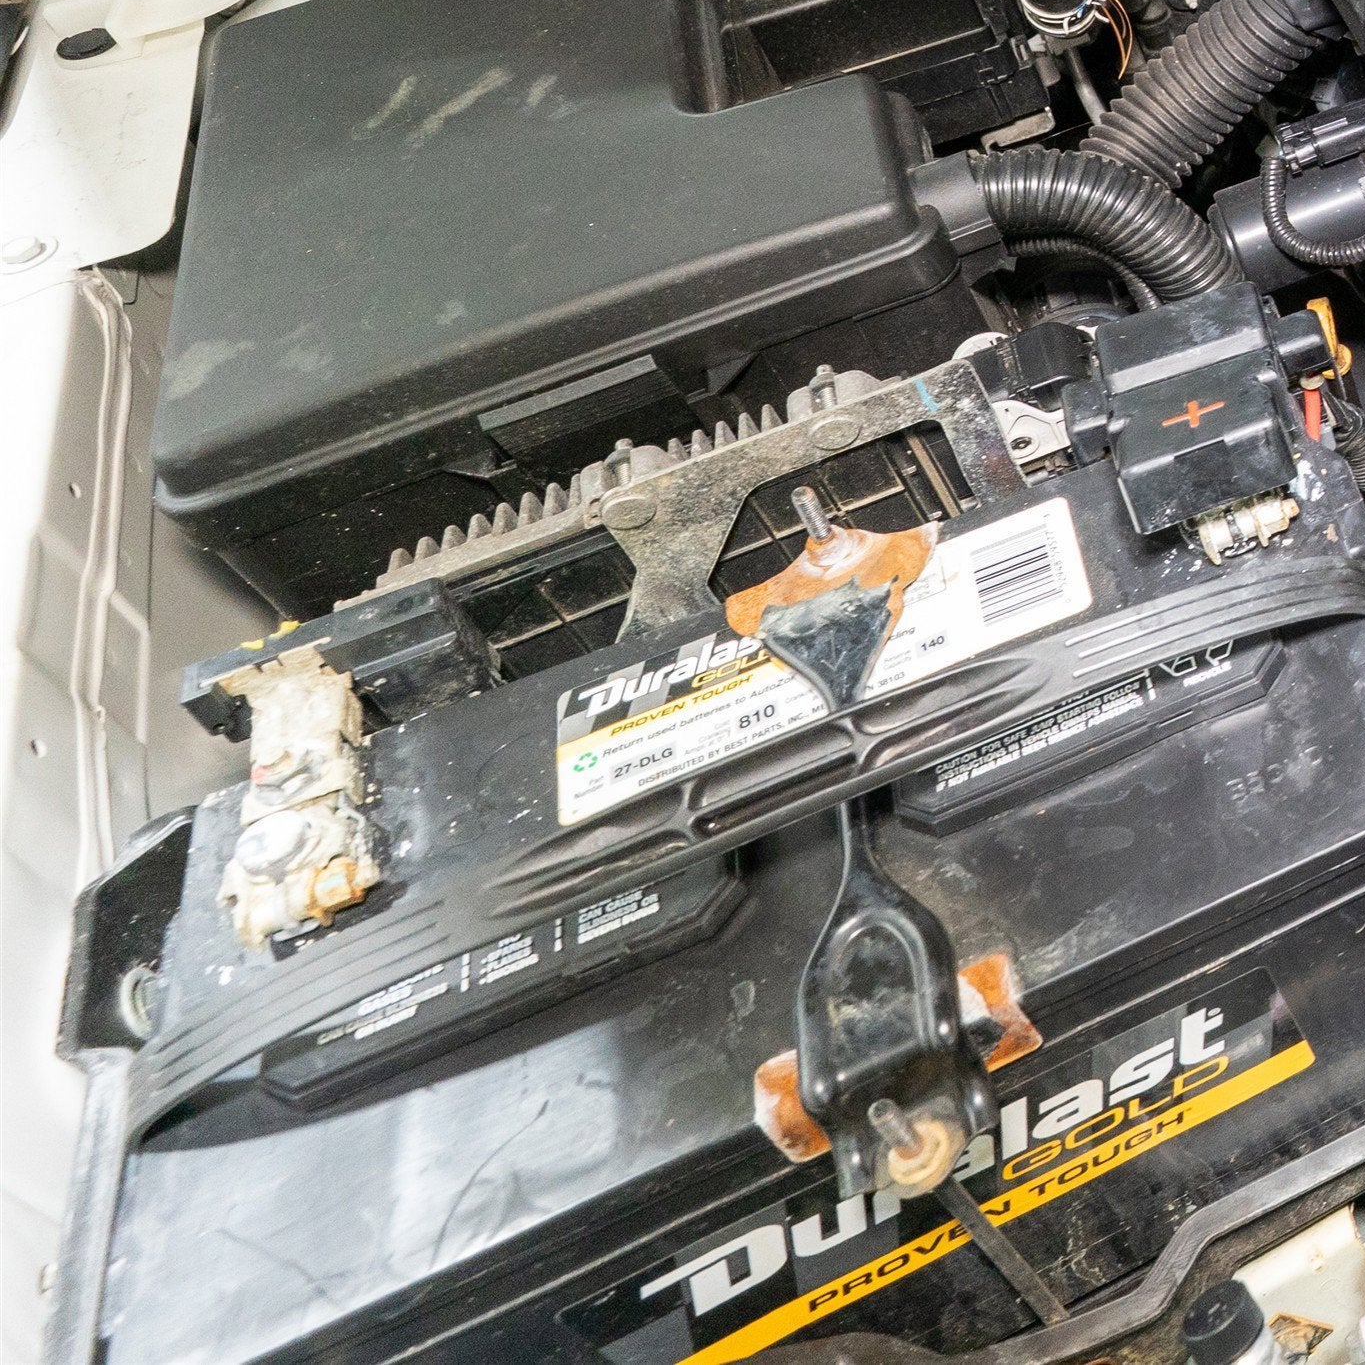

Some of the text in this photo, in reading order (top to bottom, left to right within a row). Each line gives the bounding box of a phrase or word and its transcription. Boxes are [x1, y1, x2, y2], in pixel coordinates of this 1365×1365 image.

[691, 649, 770, 688] GOL
[920, 635, 945, 652] 140
[577, 636, 764, 718] Duralas
[610, 674, 754, 737] PROVEN TOUGH
[602, 736, 643, 758] Return
[647, 722, 676, 740] used
[679, 701, 732, 728] batteries
[735, 695, 746, 707] to
[749, 674, 799, 699] AutoZo
[613, 746, 674, 779] 27-DLG
[738, 704, 777, 731] 810
[934, 750, 978, 774] CAUTION
[980, 740, 1001, 754] FOR
[1002, 729, 1028, 745] SAFE
[1028, 717, 1055, 734] JUMP
[1055, 697, 1102, 723] STARTING
[1101, 680, 1141, 702] FOLLOW
[638, 753, 705, 787] DISTRIBUTED
[707, 746, 722, 761] BY
[724, 736, 749, 753] BEST
[936, 747, 1007, 782] INSTRUCTIONS
[1007, 742, 1019, 752] IN
[1020, 724, 1060, 747] VEHICLE
[946, 771, 970, 787] NOT
[576, 906, 605, 923] CAN
[603, 890, 644, 912] CAUSE
[1003, 1055, 1229, 1181] GOLD
[1036, 1112, 1182, 1197] TOUGH
